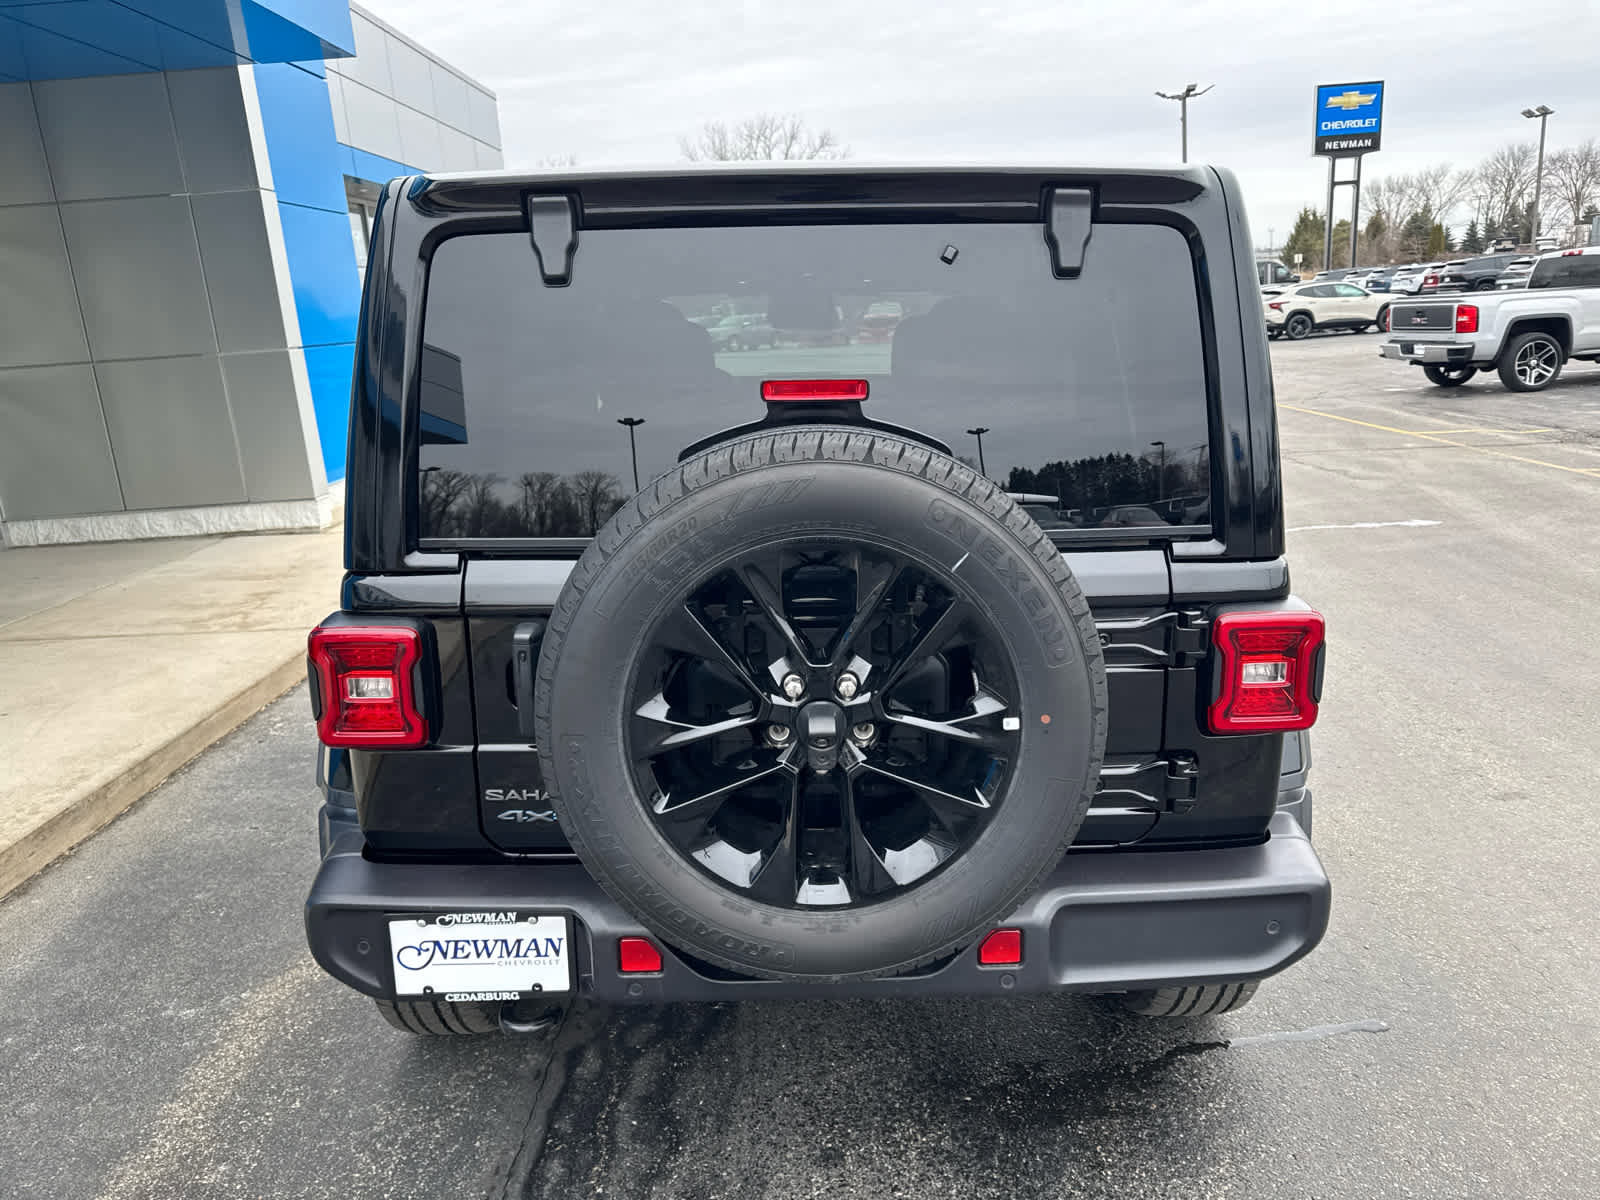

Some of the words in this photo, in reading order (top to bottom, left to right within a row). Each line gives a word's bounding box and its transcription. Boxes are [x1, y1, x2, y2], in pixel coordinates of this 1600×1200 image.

[1321, 118, 1378, 130] CHEVROLET
[1325, 139, 1372, 150] NEWMAN
[436, 912, 517, 928] NEWMAN
[397, 937, 564, 970] NEWMAN
[497, 958, 561, 967] CHEVROLET
[445, 991, 520, 1002] CEDARBURG
